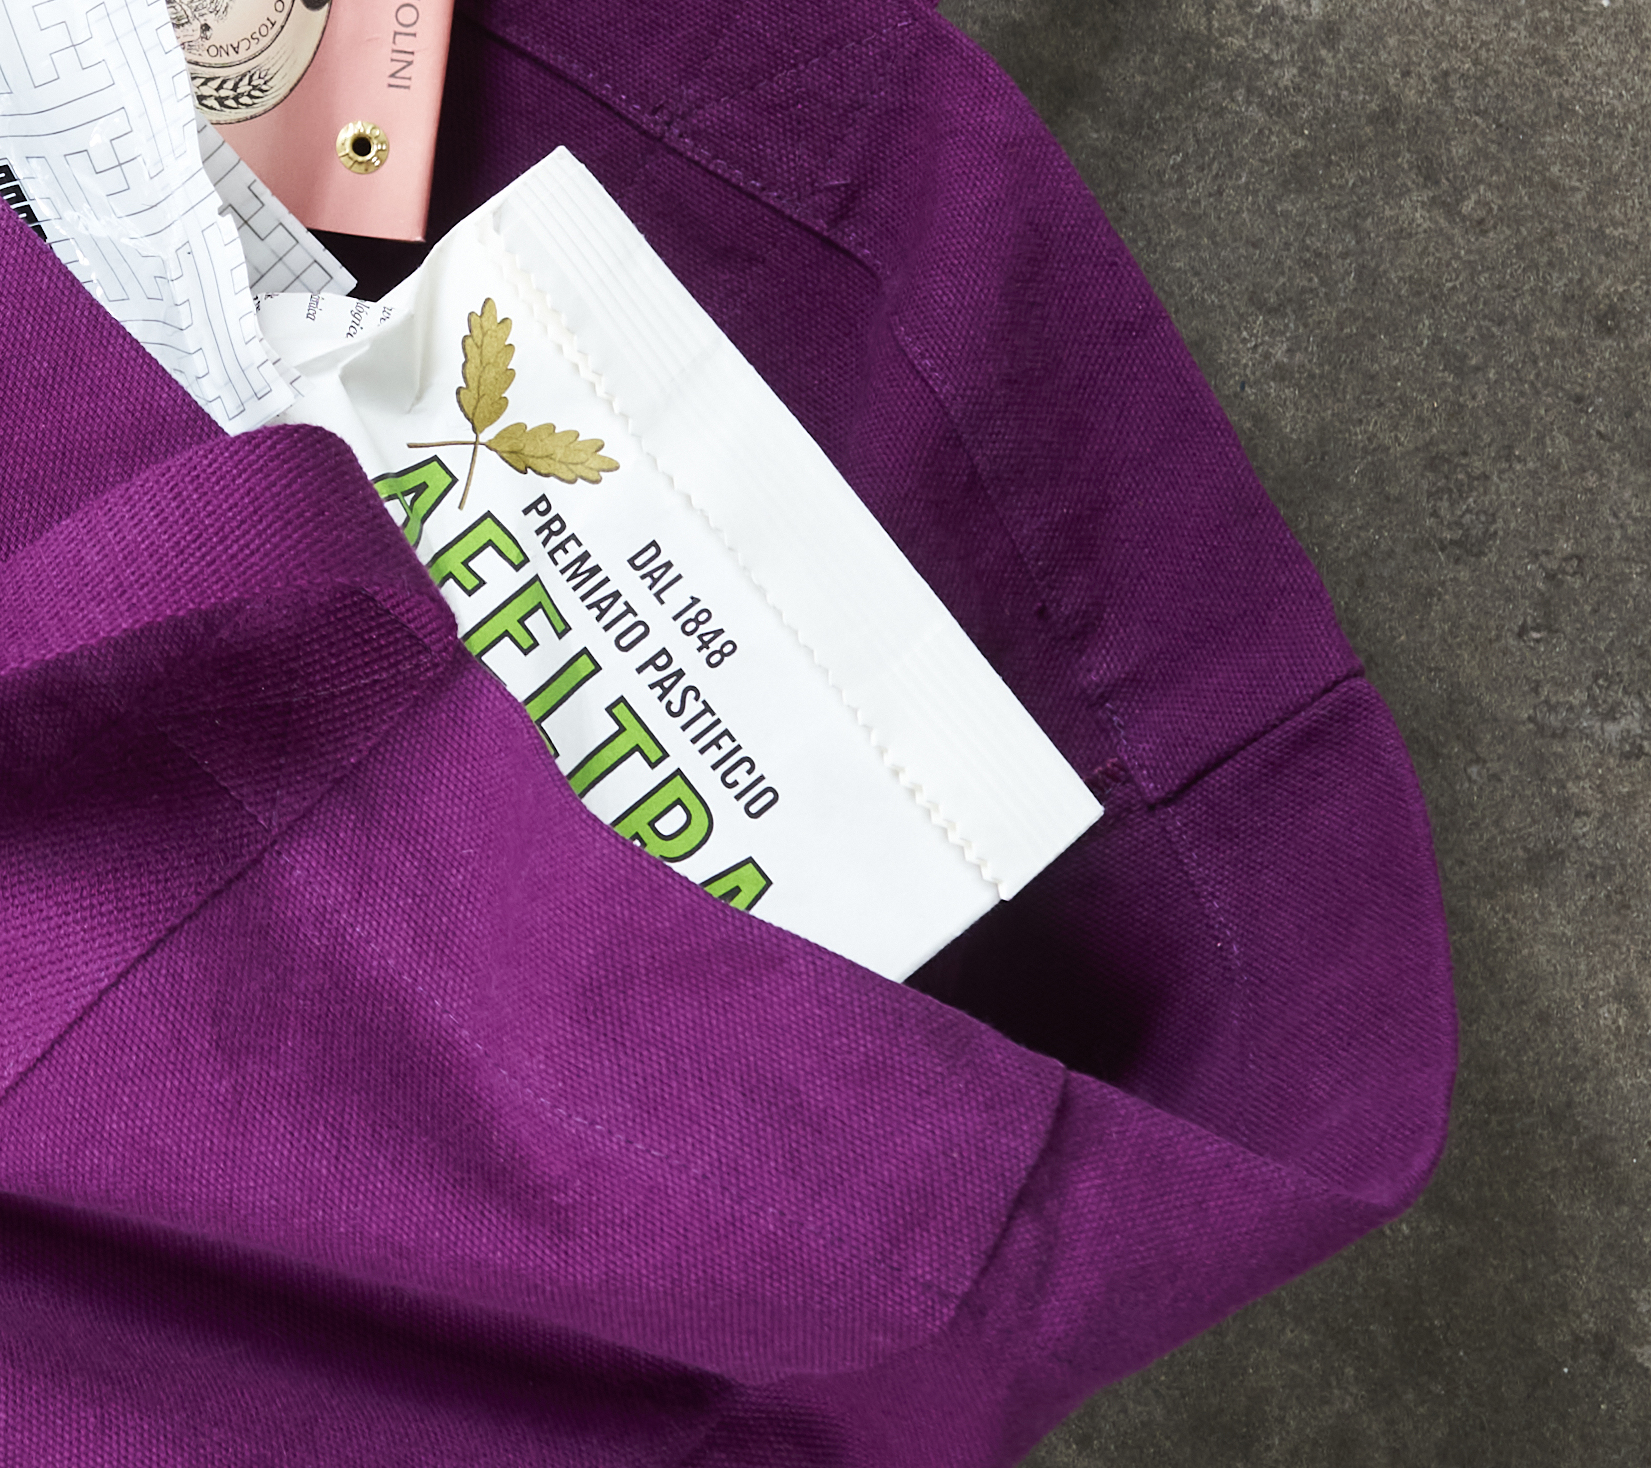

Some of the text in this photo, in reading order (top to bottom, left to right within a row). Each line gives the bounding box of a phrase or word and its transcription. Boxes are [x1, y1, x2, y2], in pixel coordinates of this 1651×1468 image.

[206, 16, 277, 59] TOSCANO
[521, 493, 780, 820] PREMIATO PASTIFICIO
[626, 539, 738, 669] DAL 1848
